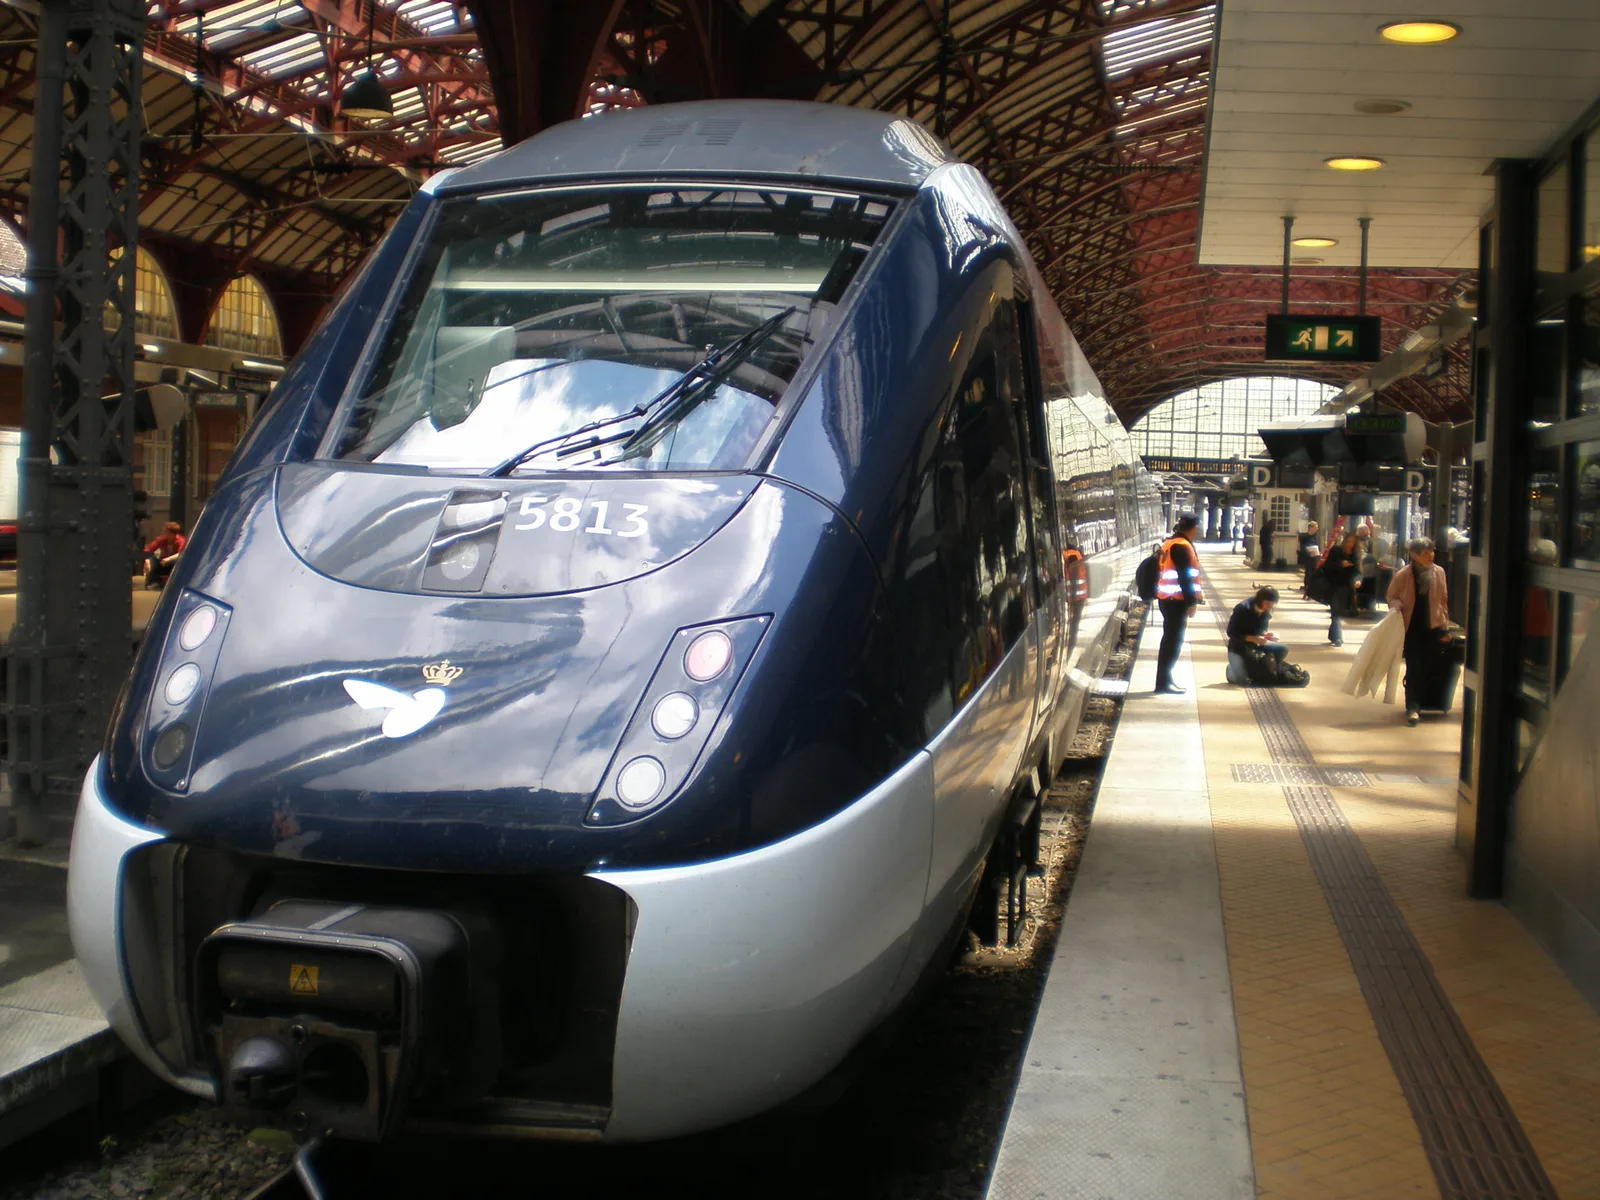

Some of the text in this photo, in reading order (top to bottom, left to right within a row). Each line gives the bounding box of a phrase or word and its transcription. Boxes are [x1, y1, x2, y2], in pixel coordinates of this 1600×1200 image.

[1253, 467, 1271, 486] D
[1406, 471, 1425, 491] D
[514, 496, 649, 538] 5813
